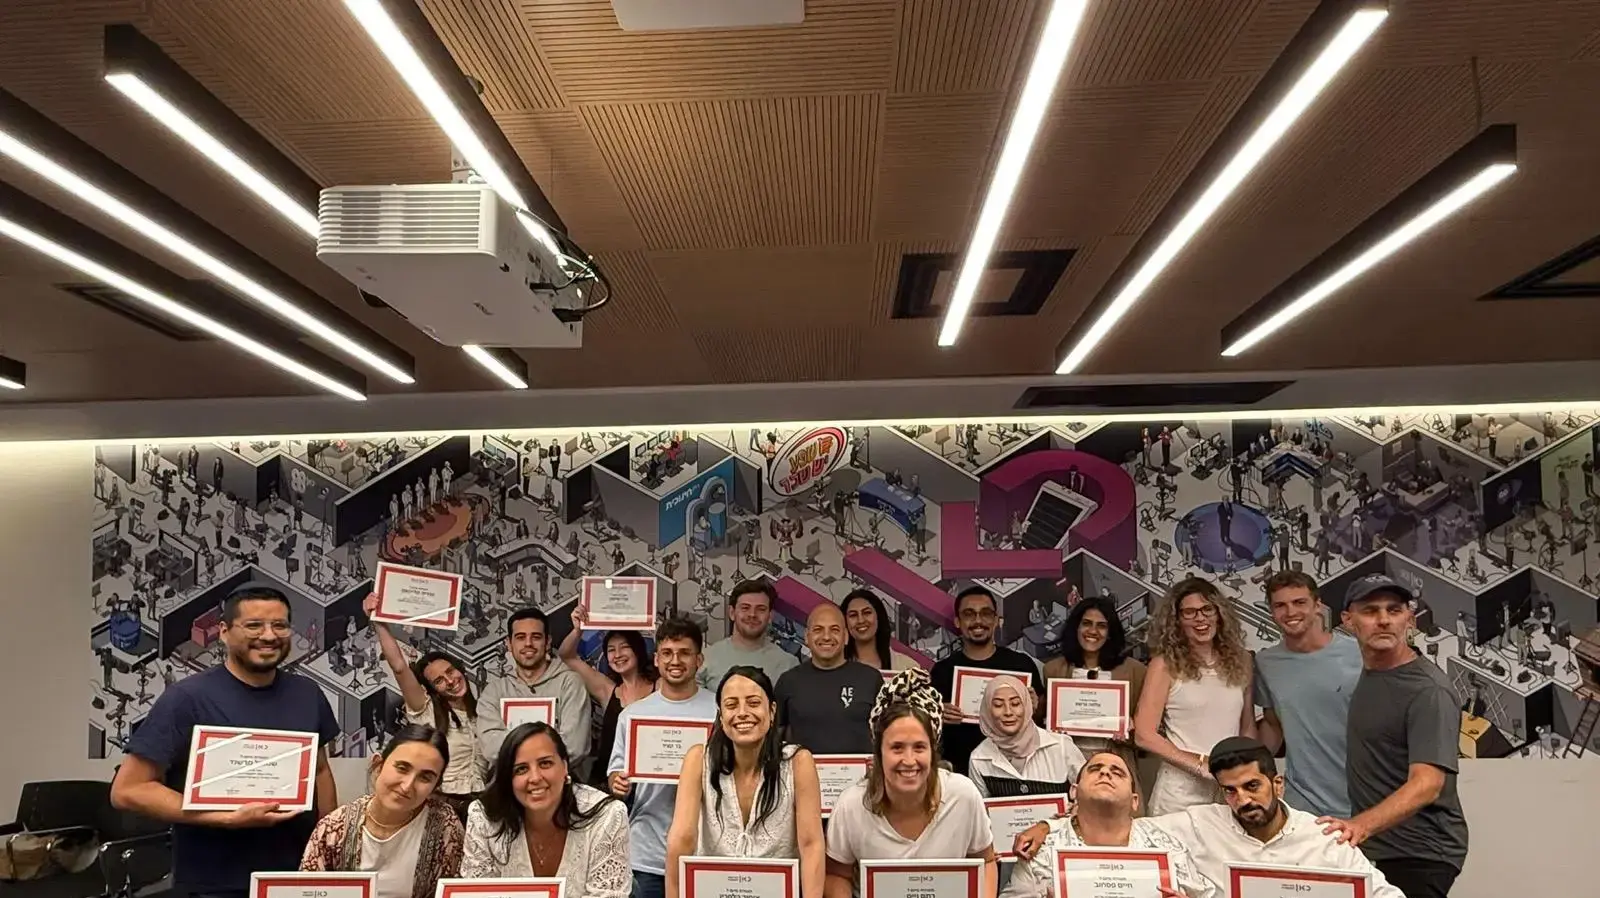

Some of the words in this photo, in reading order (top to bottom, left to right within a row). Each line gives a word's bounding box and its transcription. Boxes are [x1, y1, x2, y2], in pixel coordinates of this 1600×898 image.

[739, 875, 751, 883] כאן
[920, 875, 934, 884] כאן
[1295, 883, 1312, 892] כאן
[314, 890, 328, 898] כאן
